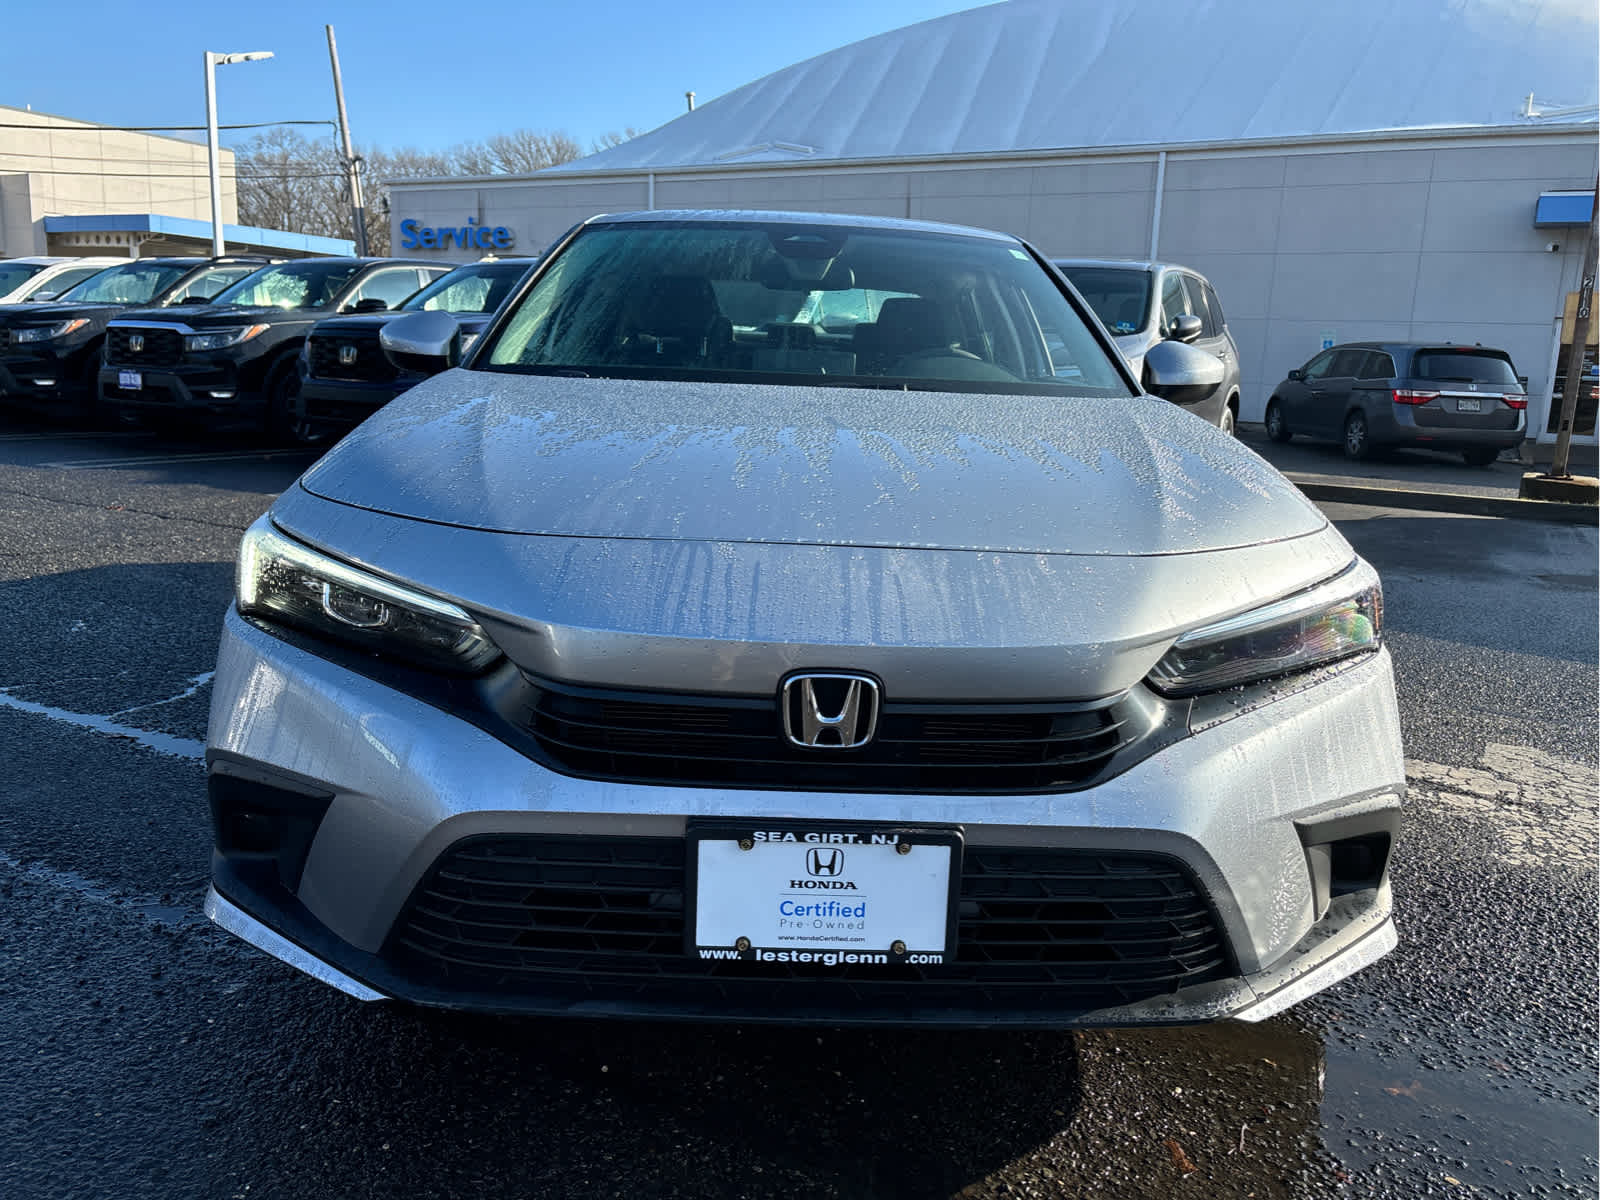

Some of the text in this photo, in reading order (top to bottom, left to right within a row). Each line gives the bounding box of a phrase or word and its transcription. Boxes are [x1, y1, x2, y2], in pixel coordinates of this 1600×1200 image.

[400, 216, 510, 248] Service
[753, 831, 797, 842] SEA
[871, 834, 899, 845] NJ
[790, 880, 858, 890] HONDA
[780, 900, 866, 917] Certified
[780, 919, 865, 930] Pre-Owned
[699, 949, 943, 966] www. lesterglenn .com
